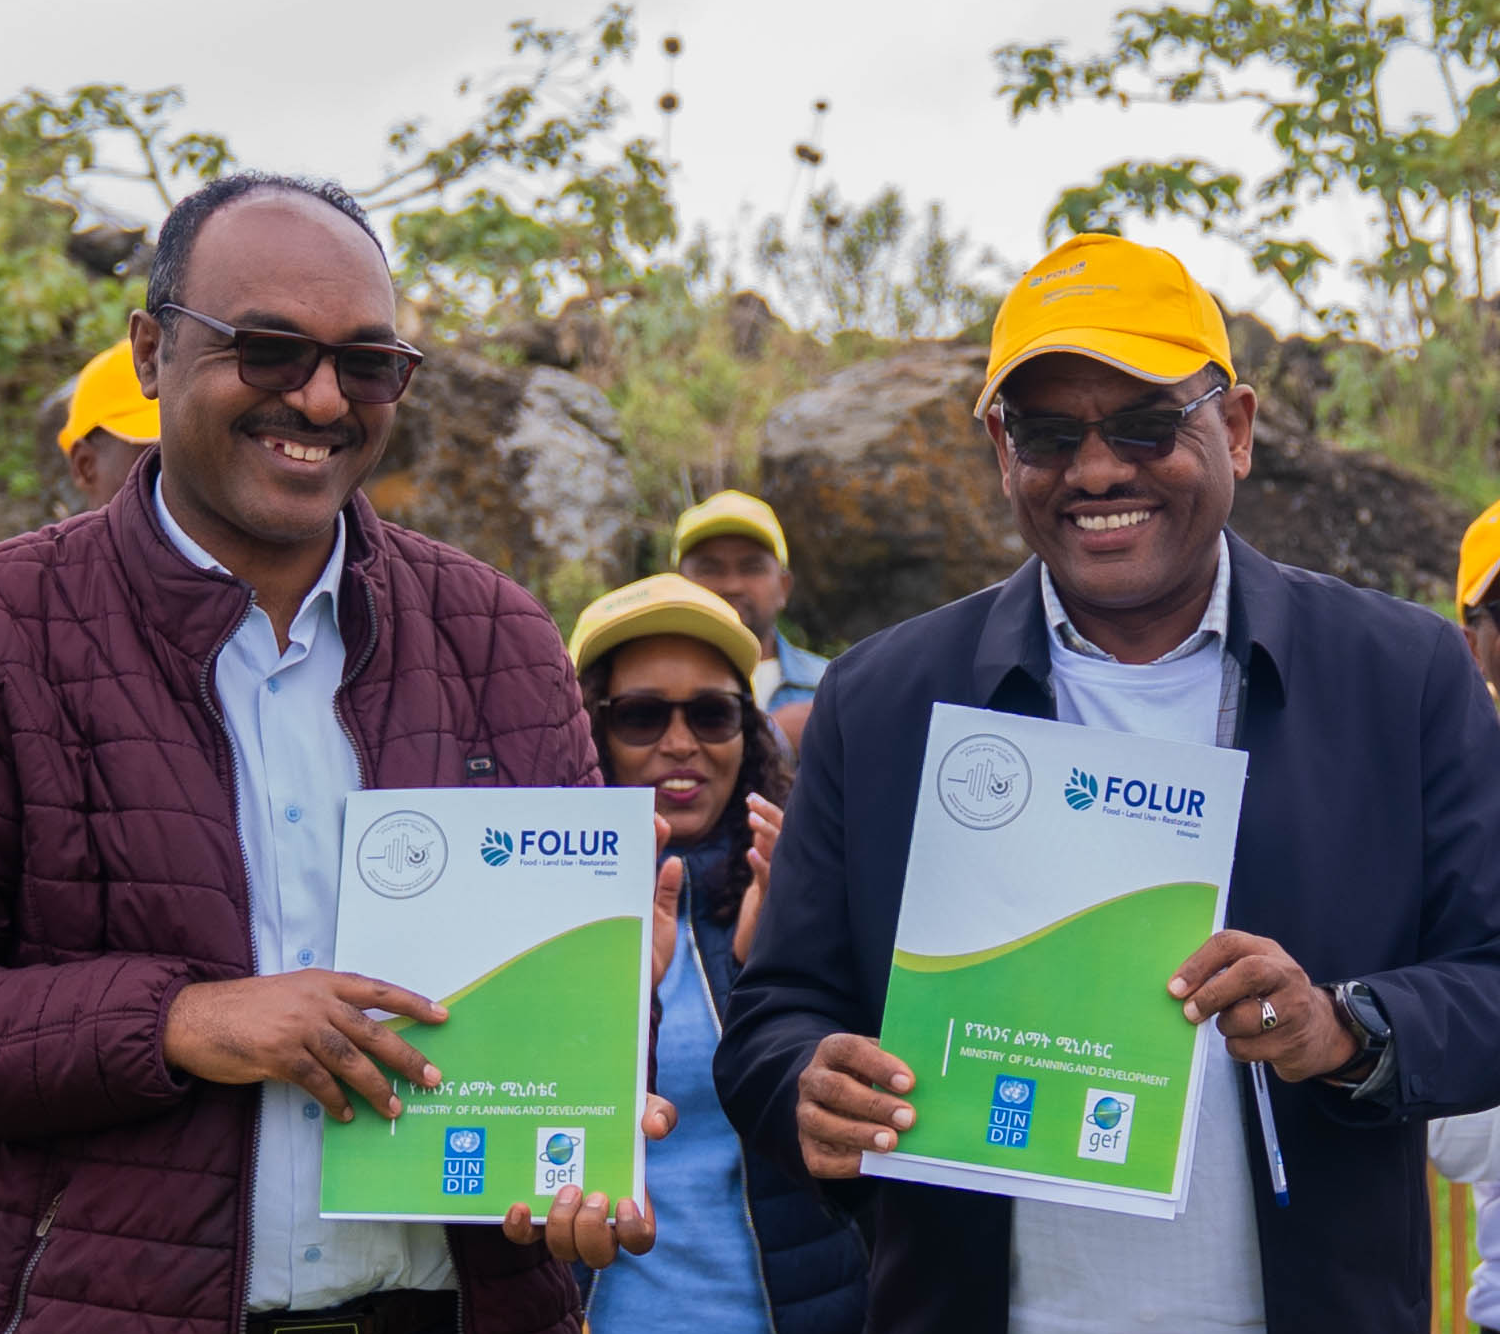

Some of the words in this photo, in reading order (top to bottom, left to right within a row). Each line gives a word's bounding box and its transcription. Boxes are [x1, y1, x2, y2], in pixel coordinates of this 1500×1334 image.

[1104, 776, 1205, 817] FOLUR
[520, 830, 619, 856] FOLUR
[1014, 1030, 1051, 1048] ልማት
[1056, 1036, 1113, 1059] ሚኒስቴር
[960, 1046, 1006, 1061] MINISTRY
[1008, 1054, 1023, 1065] OF
[1098, 1067, 1170, 1086] DEVELOPMENT
[459, 1080, 496, 1096] ልማት
[500, 1081, 556, 1097] ሚኒስቴር
[407, 1104, 452, 1115] MINISTRY
[456, 1105, 469, 1115] OF
[546, 1106, 616, 1115] DEVELOPMENT
[1088, 1130, 1122, 1152] gef
[545, 1164, 576, 1188] gef
